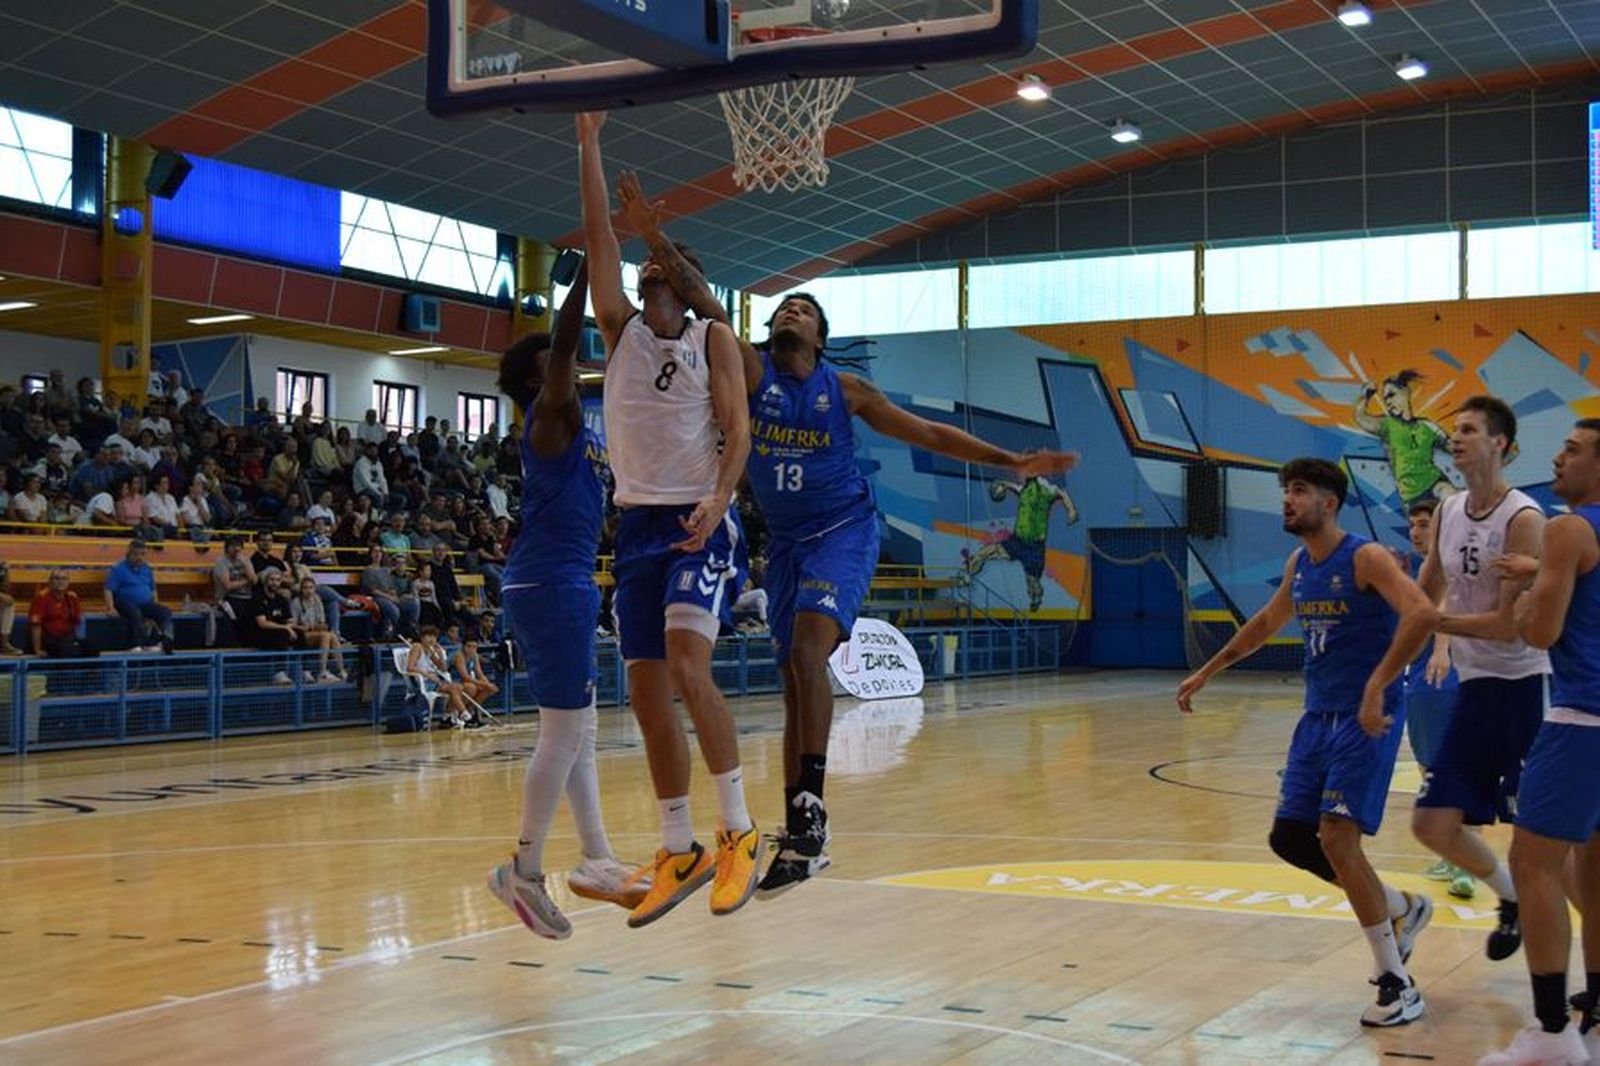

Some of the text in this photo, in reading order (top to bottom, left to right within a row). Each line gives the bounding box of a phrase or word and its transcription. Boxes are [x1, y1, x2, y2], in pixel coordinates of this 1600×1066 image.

[655, 361, 677, 392] 8
[773, 462, 804, 492] 13
[1459, 545, 1480, 576] 15
